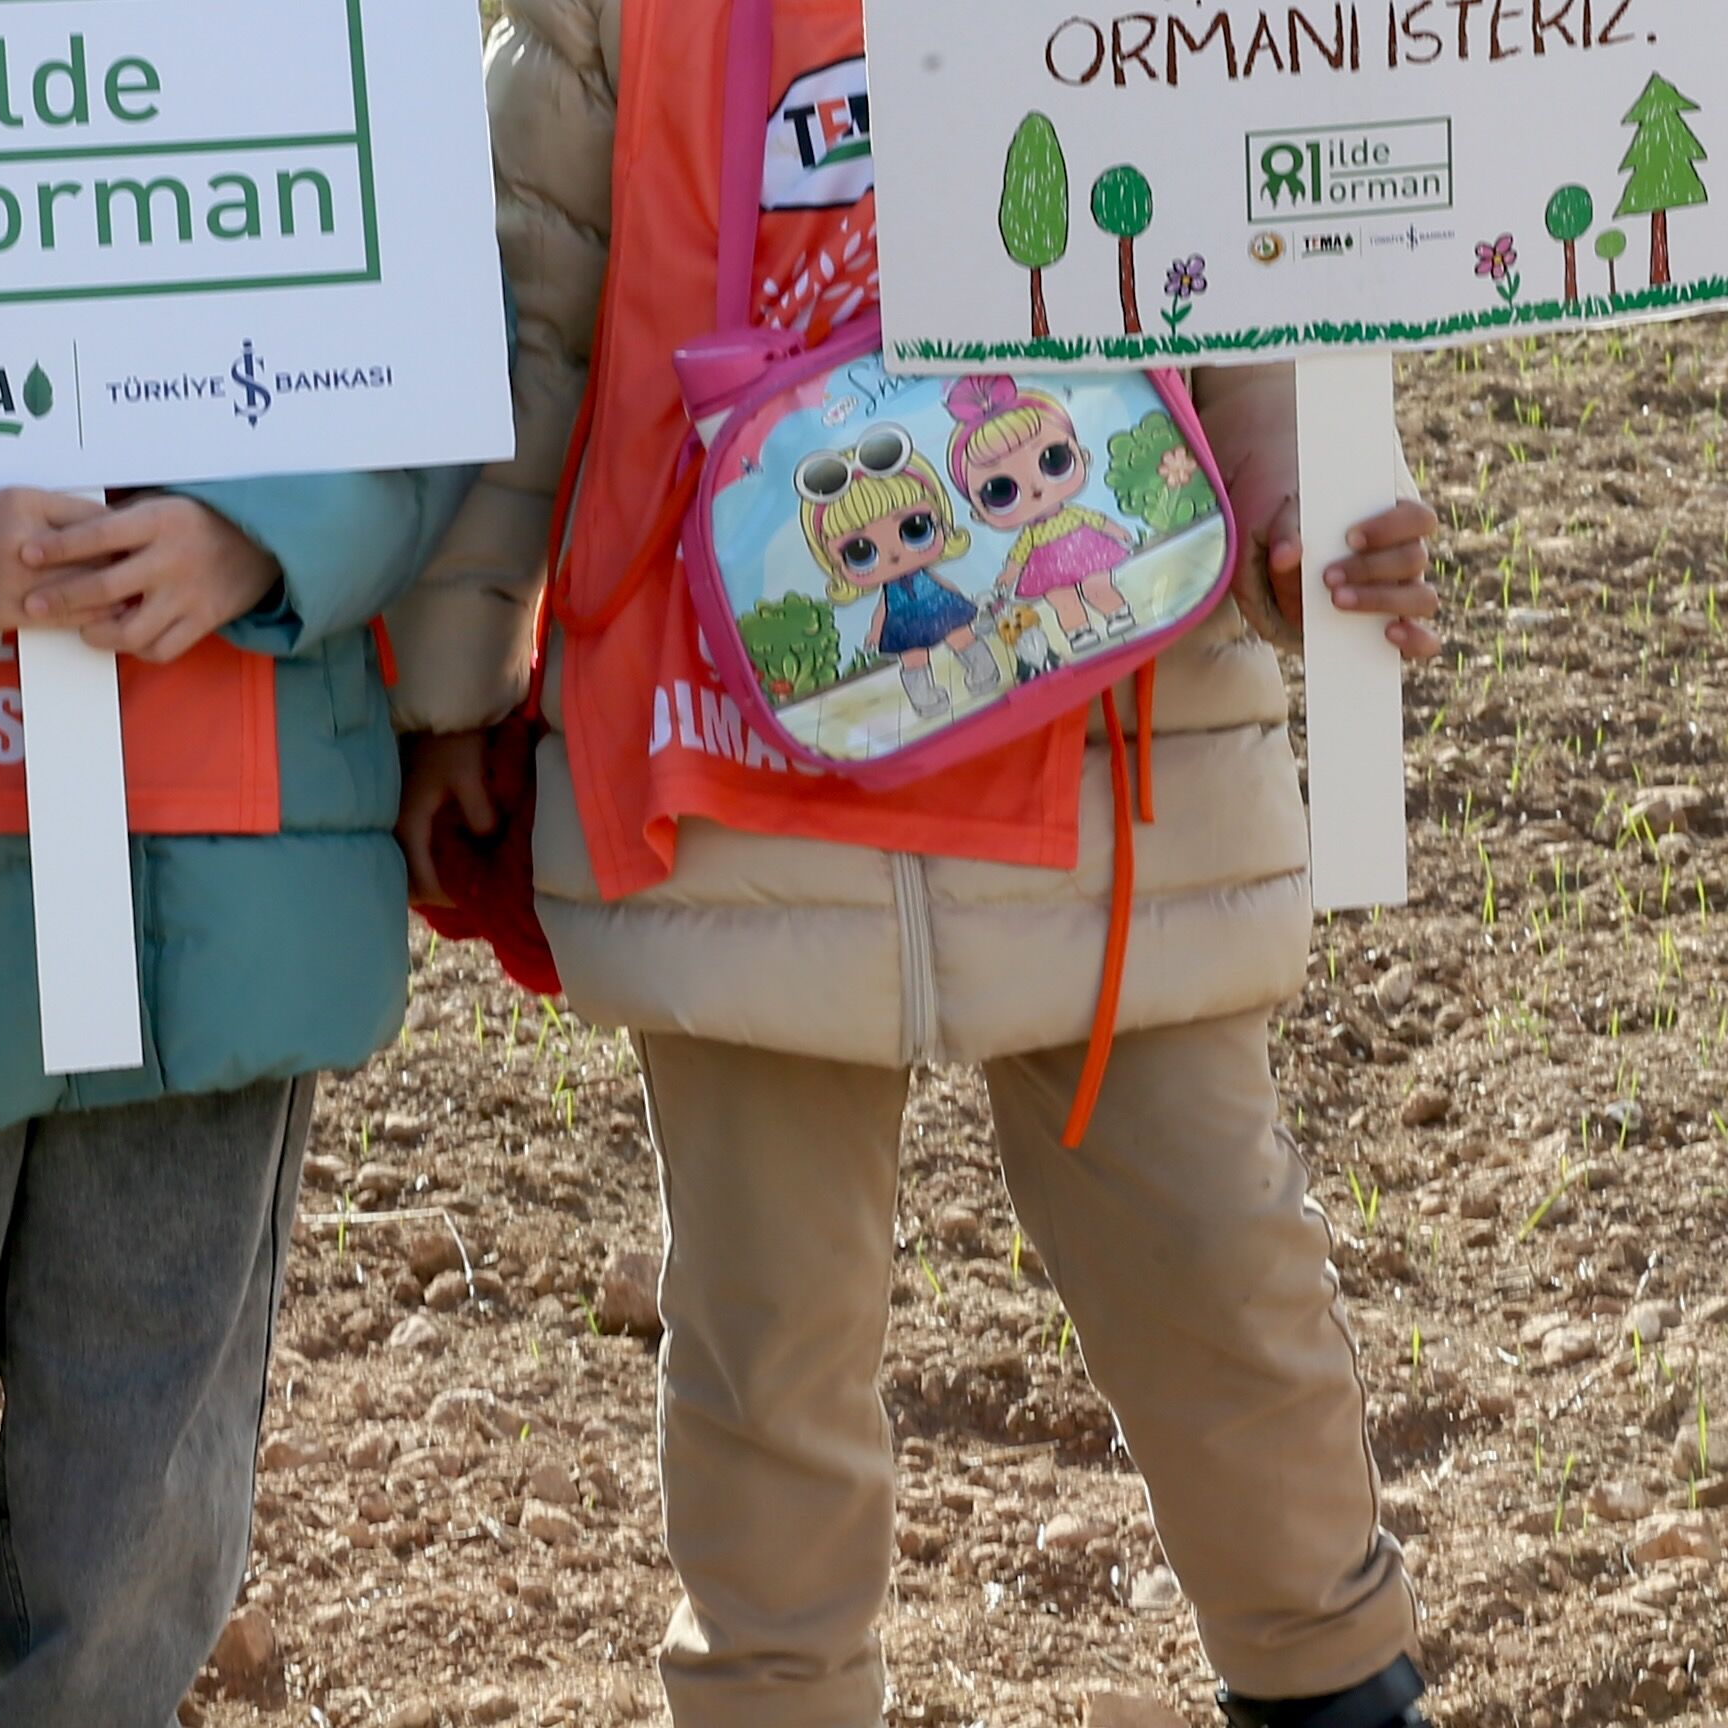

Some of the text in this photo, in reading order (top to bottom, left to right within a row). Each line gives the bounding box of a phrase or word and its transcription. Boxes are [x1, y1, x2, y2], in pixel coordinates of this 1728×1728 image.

[1045, 1, 1360, 87] ORMANI
[1261, 137, 1391, 210] 81 ilde
[1329, 173, 1440, 203] orman
[1304, 233, 1342, 253] TEMA
[106, 373, 226, 404] TÜRKİYE
[276, 365, 393, 395] BANKASI
